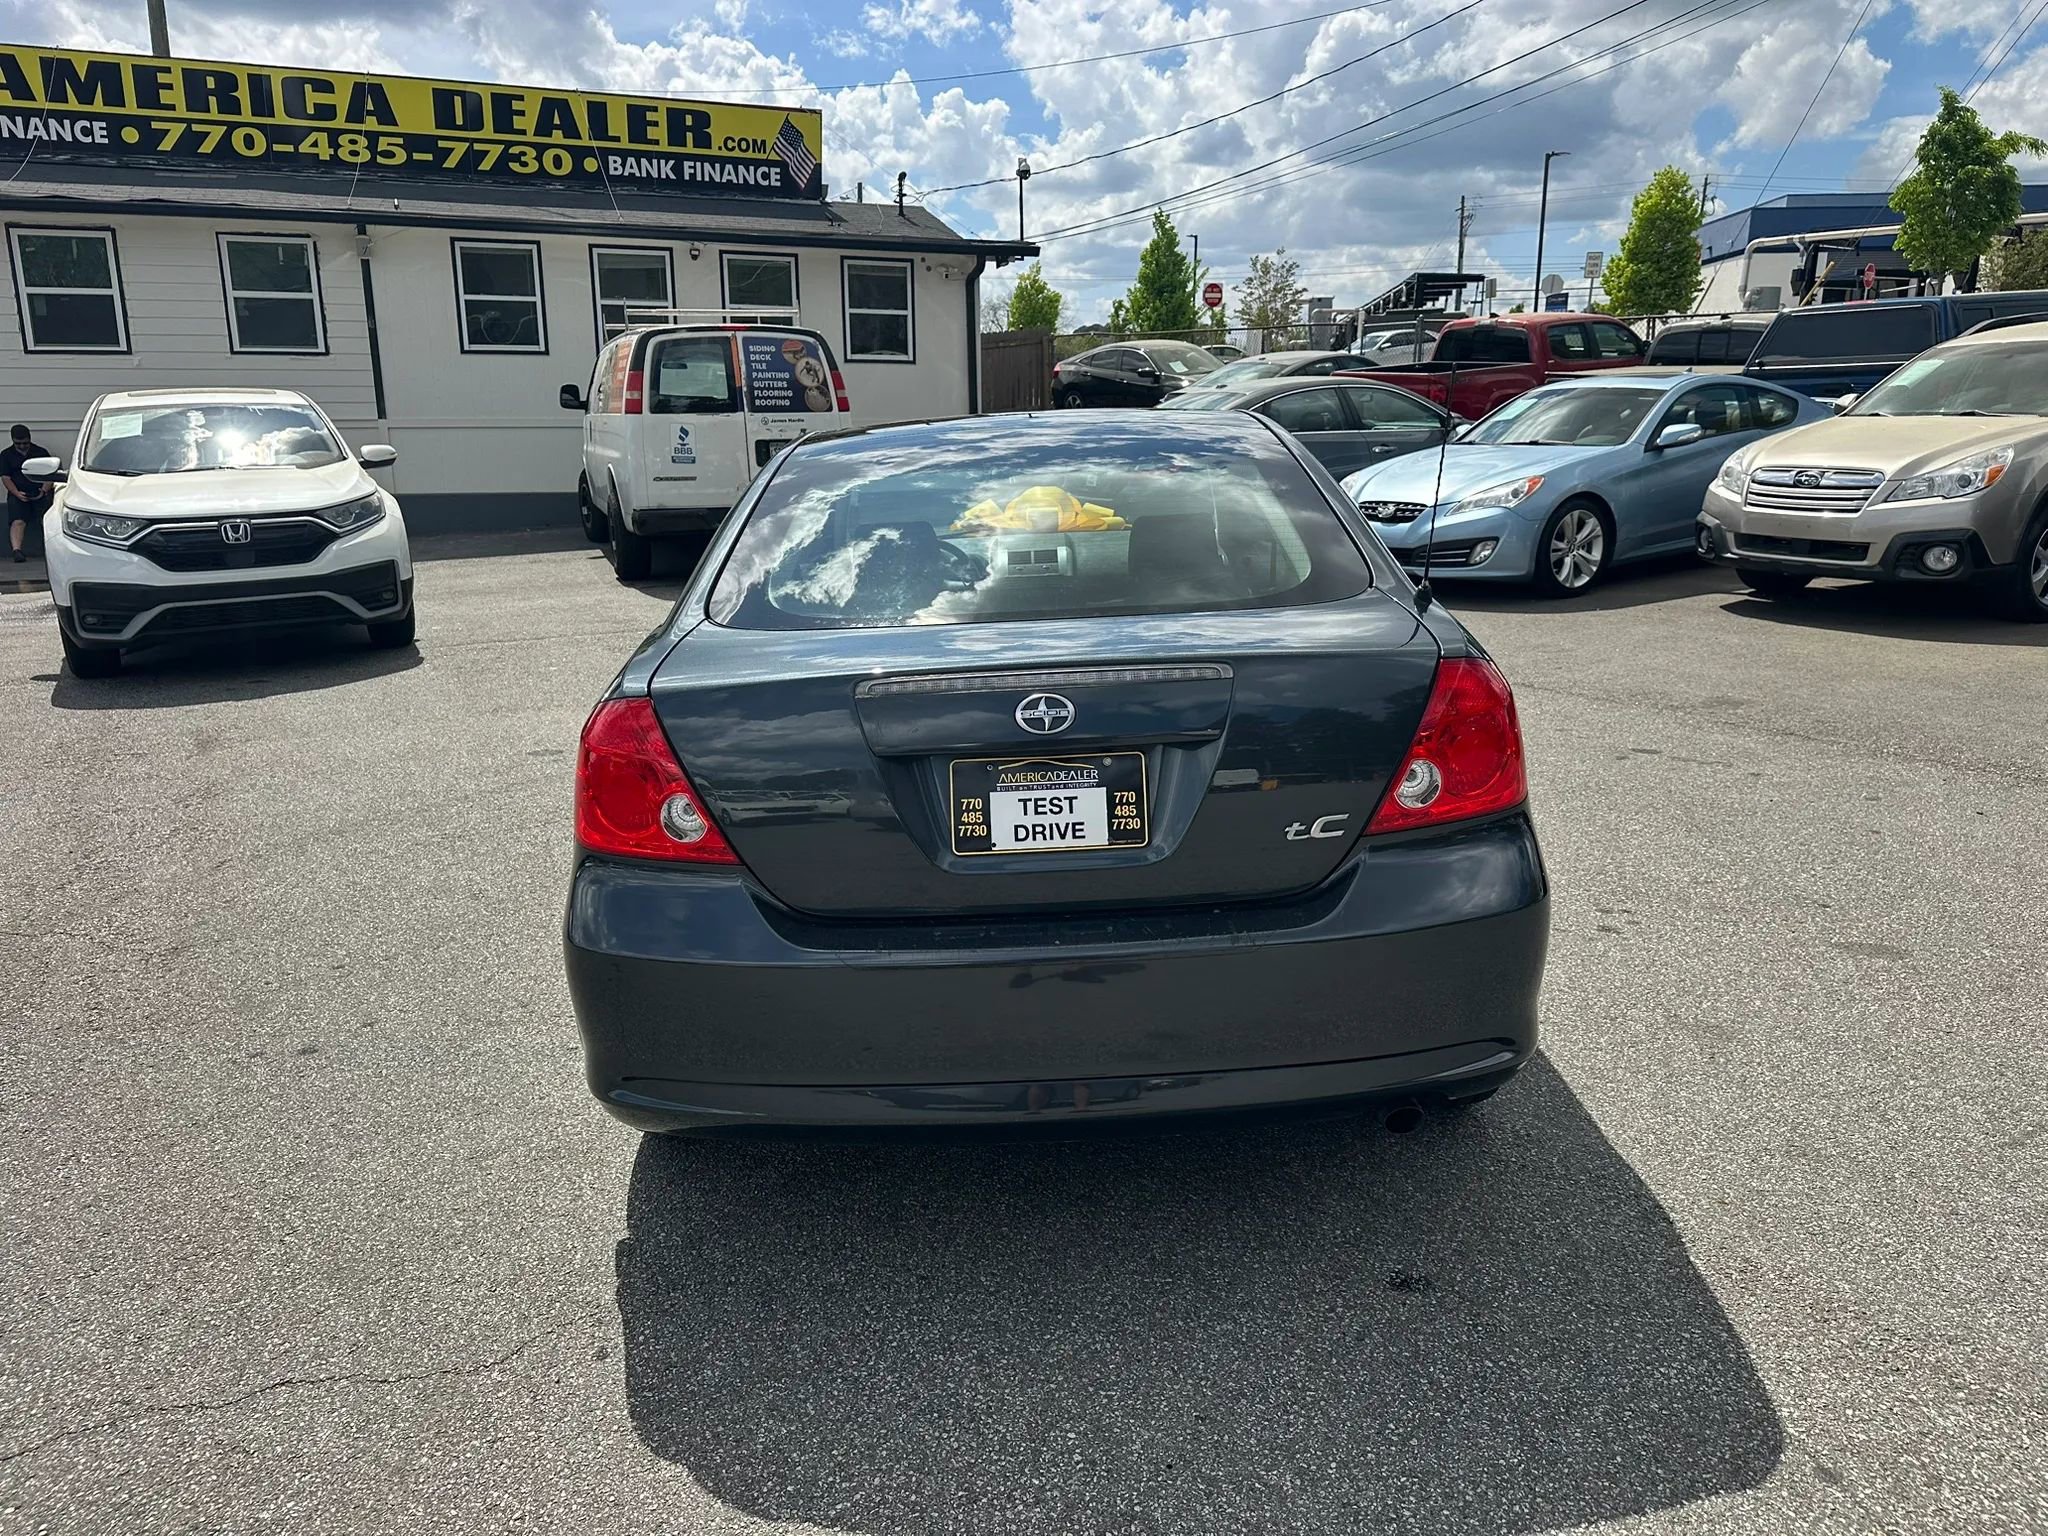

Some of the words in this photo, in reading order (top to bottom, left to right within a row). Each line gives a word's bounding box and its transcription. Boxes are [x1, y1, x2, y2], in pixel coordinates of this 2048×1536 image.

[0, 53, 400, 127] AMERICA
[432, 87, 712, 150] DEALER
[0, 114, 109, 144] NANCE
[150, 121, 573, 176] 770-485-7730
[607, 155, 677, 180] BANK
[683, 161, 781, 187] FINANCE
[673, 446, 693, 455] BBB
[1113, 791, 1136, 803] 770
[960, 798, 983, 810] 770
[1018, 795, 1078, 816] TEST
[961, 811, 984, 823] 485
[1114, 805, 1137, 817] 485
[1111, 817, 1141, 830] 7730
[1284, 813, 1350, 840] tC
[958, 824, 987, 837] 7730
[1014, 822, 1086, 842] DRIVE
